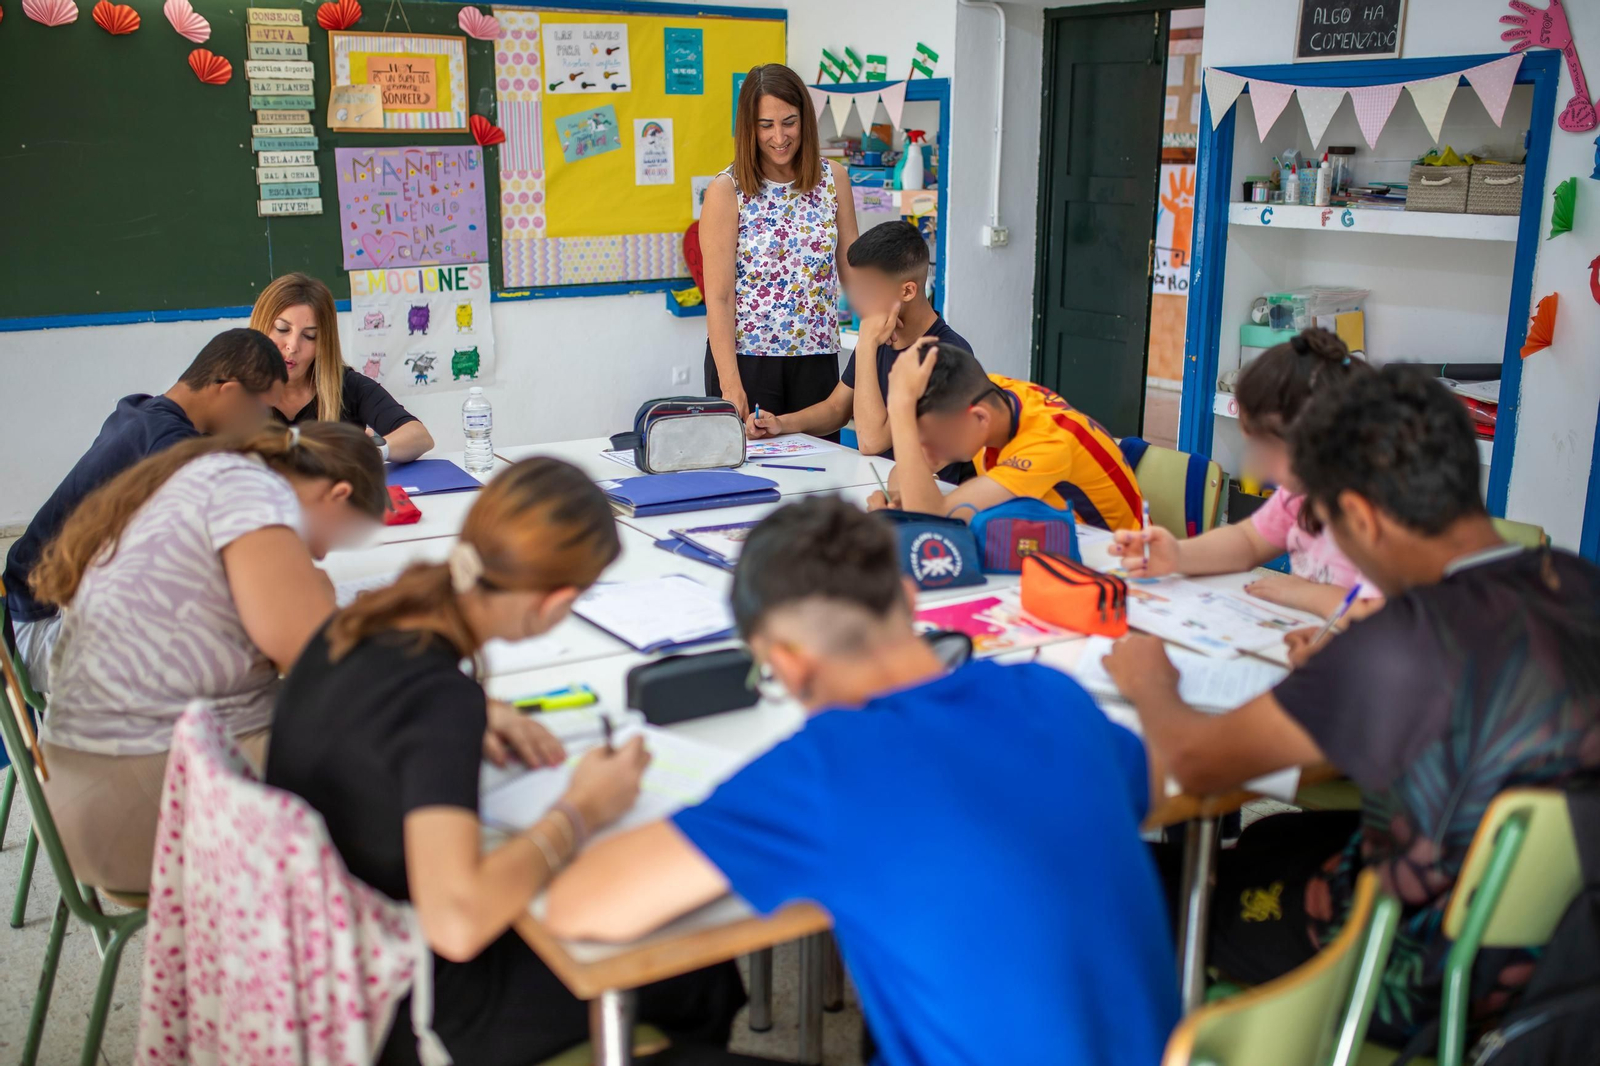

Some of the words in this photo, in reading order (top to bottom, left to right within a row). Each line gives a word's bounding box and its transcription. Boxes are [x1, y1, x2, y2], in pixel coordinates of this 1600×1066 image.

[251, 12, 301, 22] CONSEJOS
[1313, 7, 1352, 25] ALGO
[1363, 4, 1385, 20] HA
[1540, 12, 1553, 44] STOP
[254, 47, 281, 56] VIAJA
[253, 82, 272, 92] HAZ
[275, 83, 310, 92] PLANES
[1570, 63, 1584, 96] IGUALES
[263, 155, 312, 164] RELAJATE
[351, 149, 482, 187] MANTENER
[264, 172, 280, 180] SAL
[282, 171, 288, 179] A
[290, 171, 315, 179] CENAR
[402, 179, 424, 202] EL
[371, 198, 460, 225] SILENCIO
[1260, 206, 1274, 225] C
[1321, 208, 1333, 227] F
[1340, 209, 1355, 228] G
[413, 223, 436, 244] EN
[397, 238, 457, 262] CLASE
[350, 265, 483, 297] EMOCIONES
